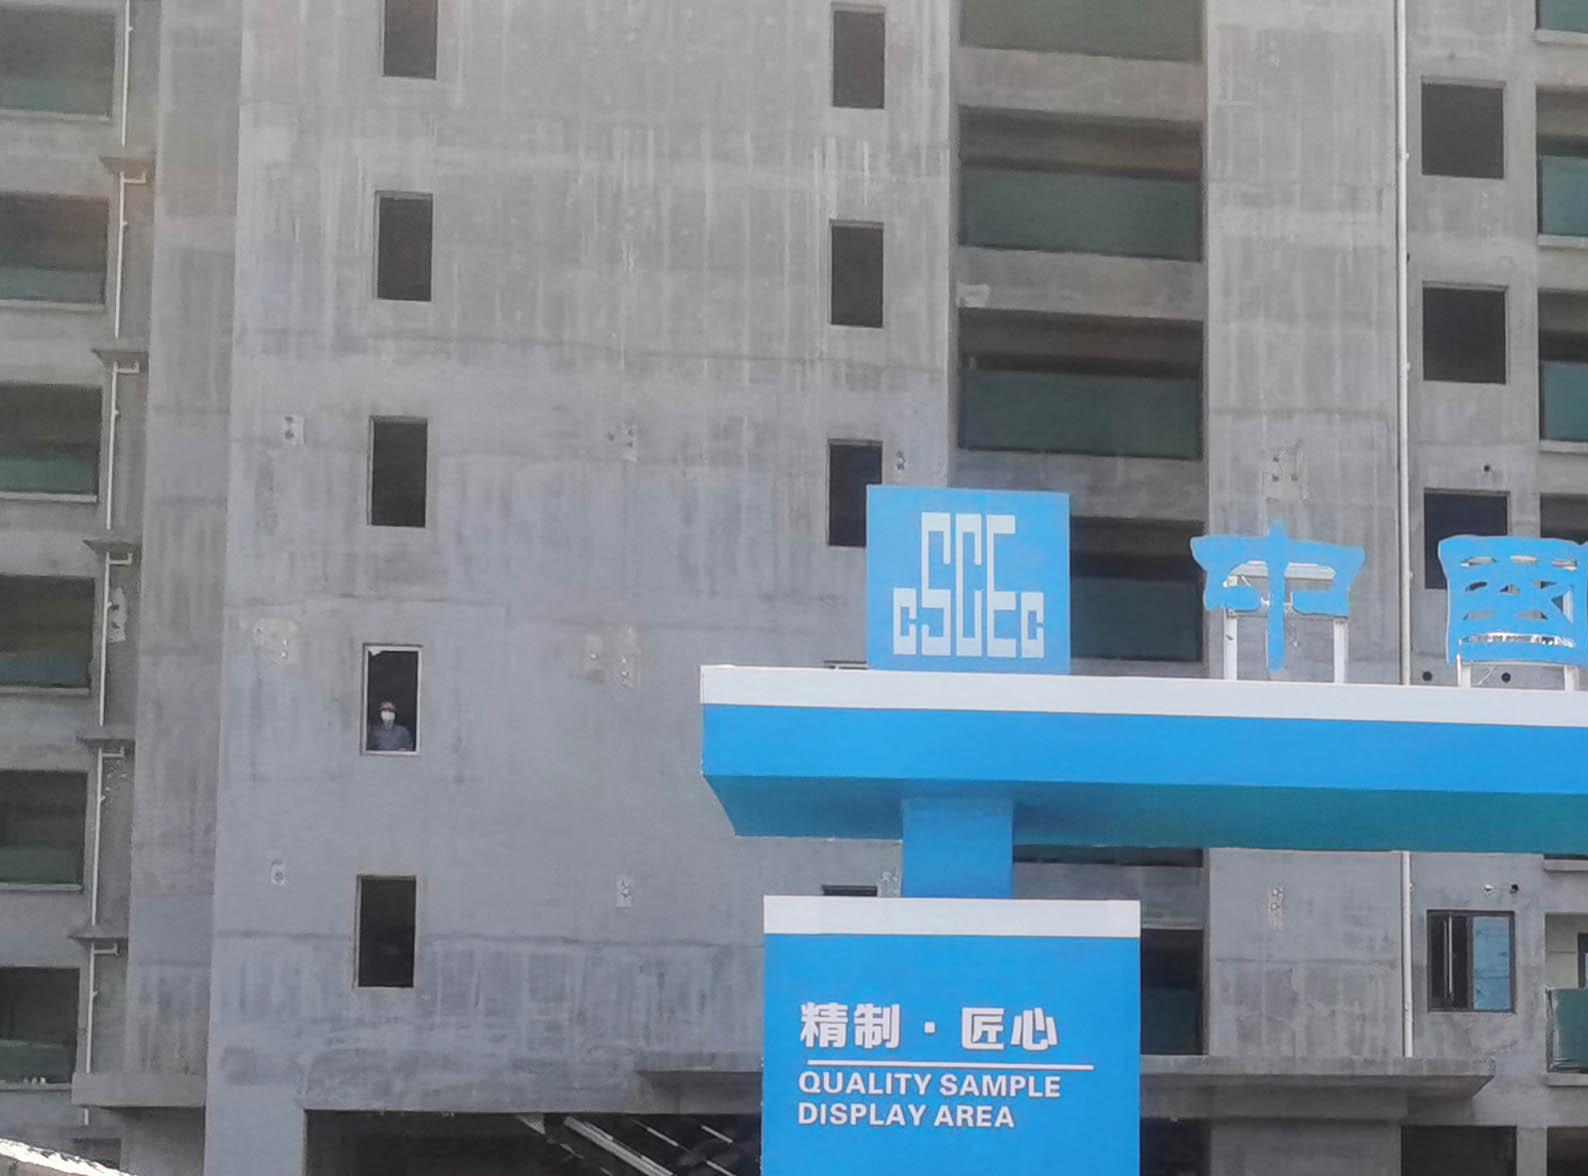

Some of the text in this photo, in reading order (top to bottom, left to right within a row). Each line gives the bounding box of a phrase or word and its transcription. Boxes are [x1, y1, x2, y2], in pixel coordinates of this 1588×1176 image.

[893, 511, 1045, 658] CSCEC
[798, 1071, 1061, 1099] QUALITY SAMPLE
[798, 1102, 1015, 1128] DISPLAY AREA
